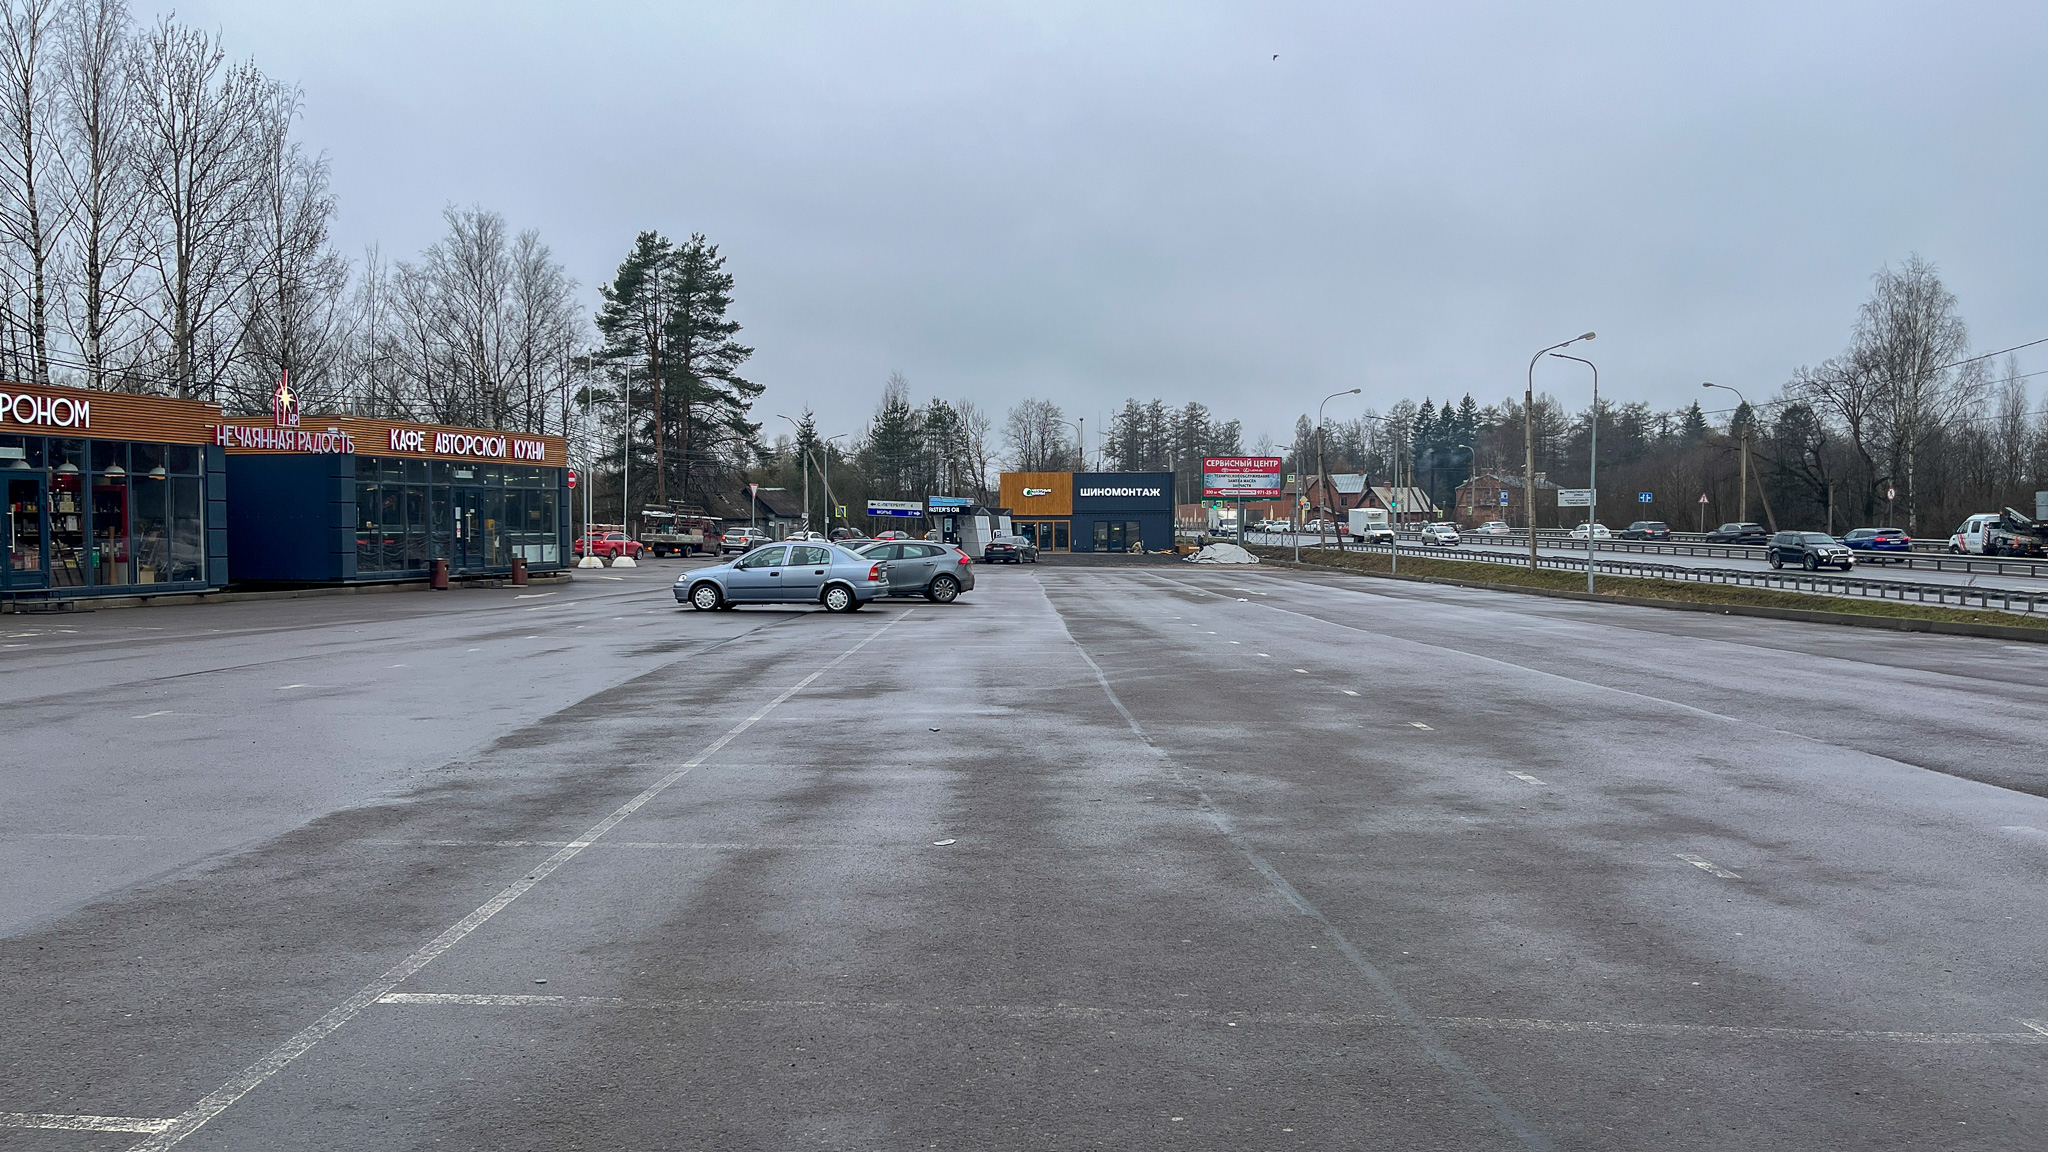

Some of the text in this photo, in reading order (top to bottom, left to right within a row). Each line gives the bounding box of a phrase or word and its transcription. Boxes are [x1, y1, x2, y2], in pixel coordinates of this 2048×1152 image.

[215, 424, 355, 454] НЕЧАЯННАЯ РАДОСТЬ
[390, 428, 545, 461] КАФЕ АВТОРСКОЙ КУХНИ
[1206, 458, 1278, 468] СЕРВИСНЫЙ ЦЕНТР
[1080, 487, 1161, 497] ШИНОМОНТАЖ
